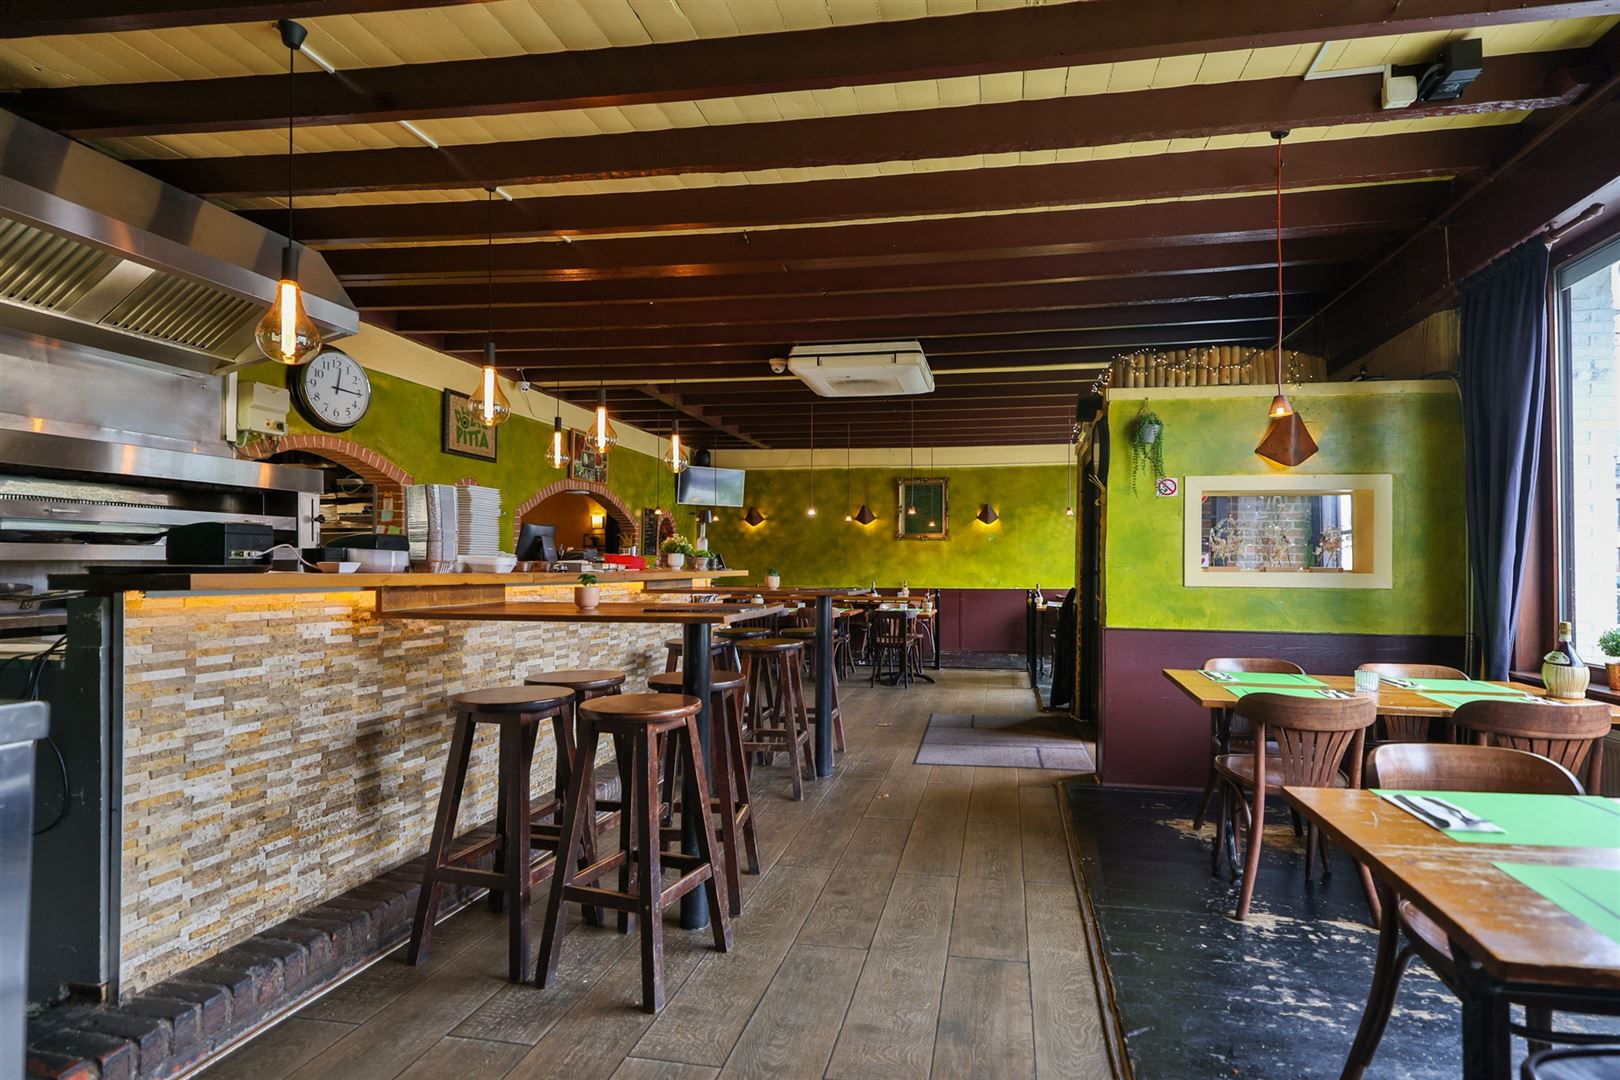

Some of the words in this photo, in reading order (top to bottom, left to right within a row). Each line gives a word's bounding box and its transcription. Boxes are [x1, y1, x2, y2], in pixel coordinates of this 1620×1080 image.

[322, 360, 330, 370] 11
[332, 359, 342, 369] 12
[314, 368, 324, 378] 10
[346, 366, 350, 375] 1
[310, 378, 317, 388] 9
[352, 375, 358, 385] 2
[313, 392, 320, 401] 8
[323, 402, 328, 412] 7
[352, 400, 358, 409] 4
[333, 408, 340, 418] 6
[345, 407, 351, 416] 5
[456, 425, 489, 449] PITTA
